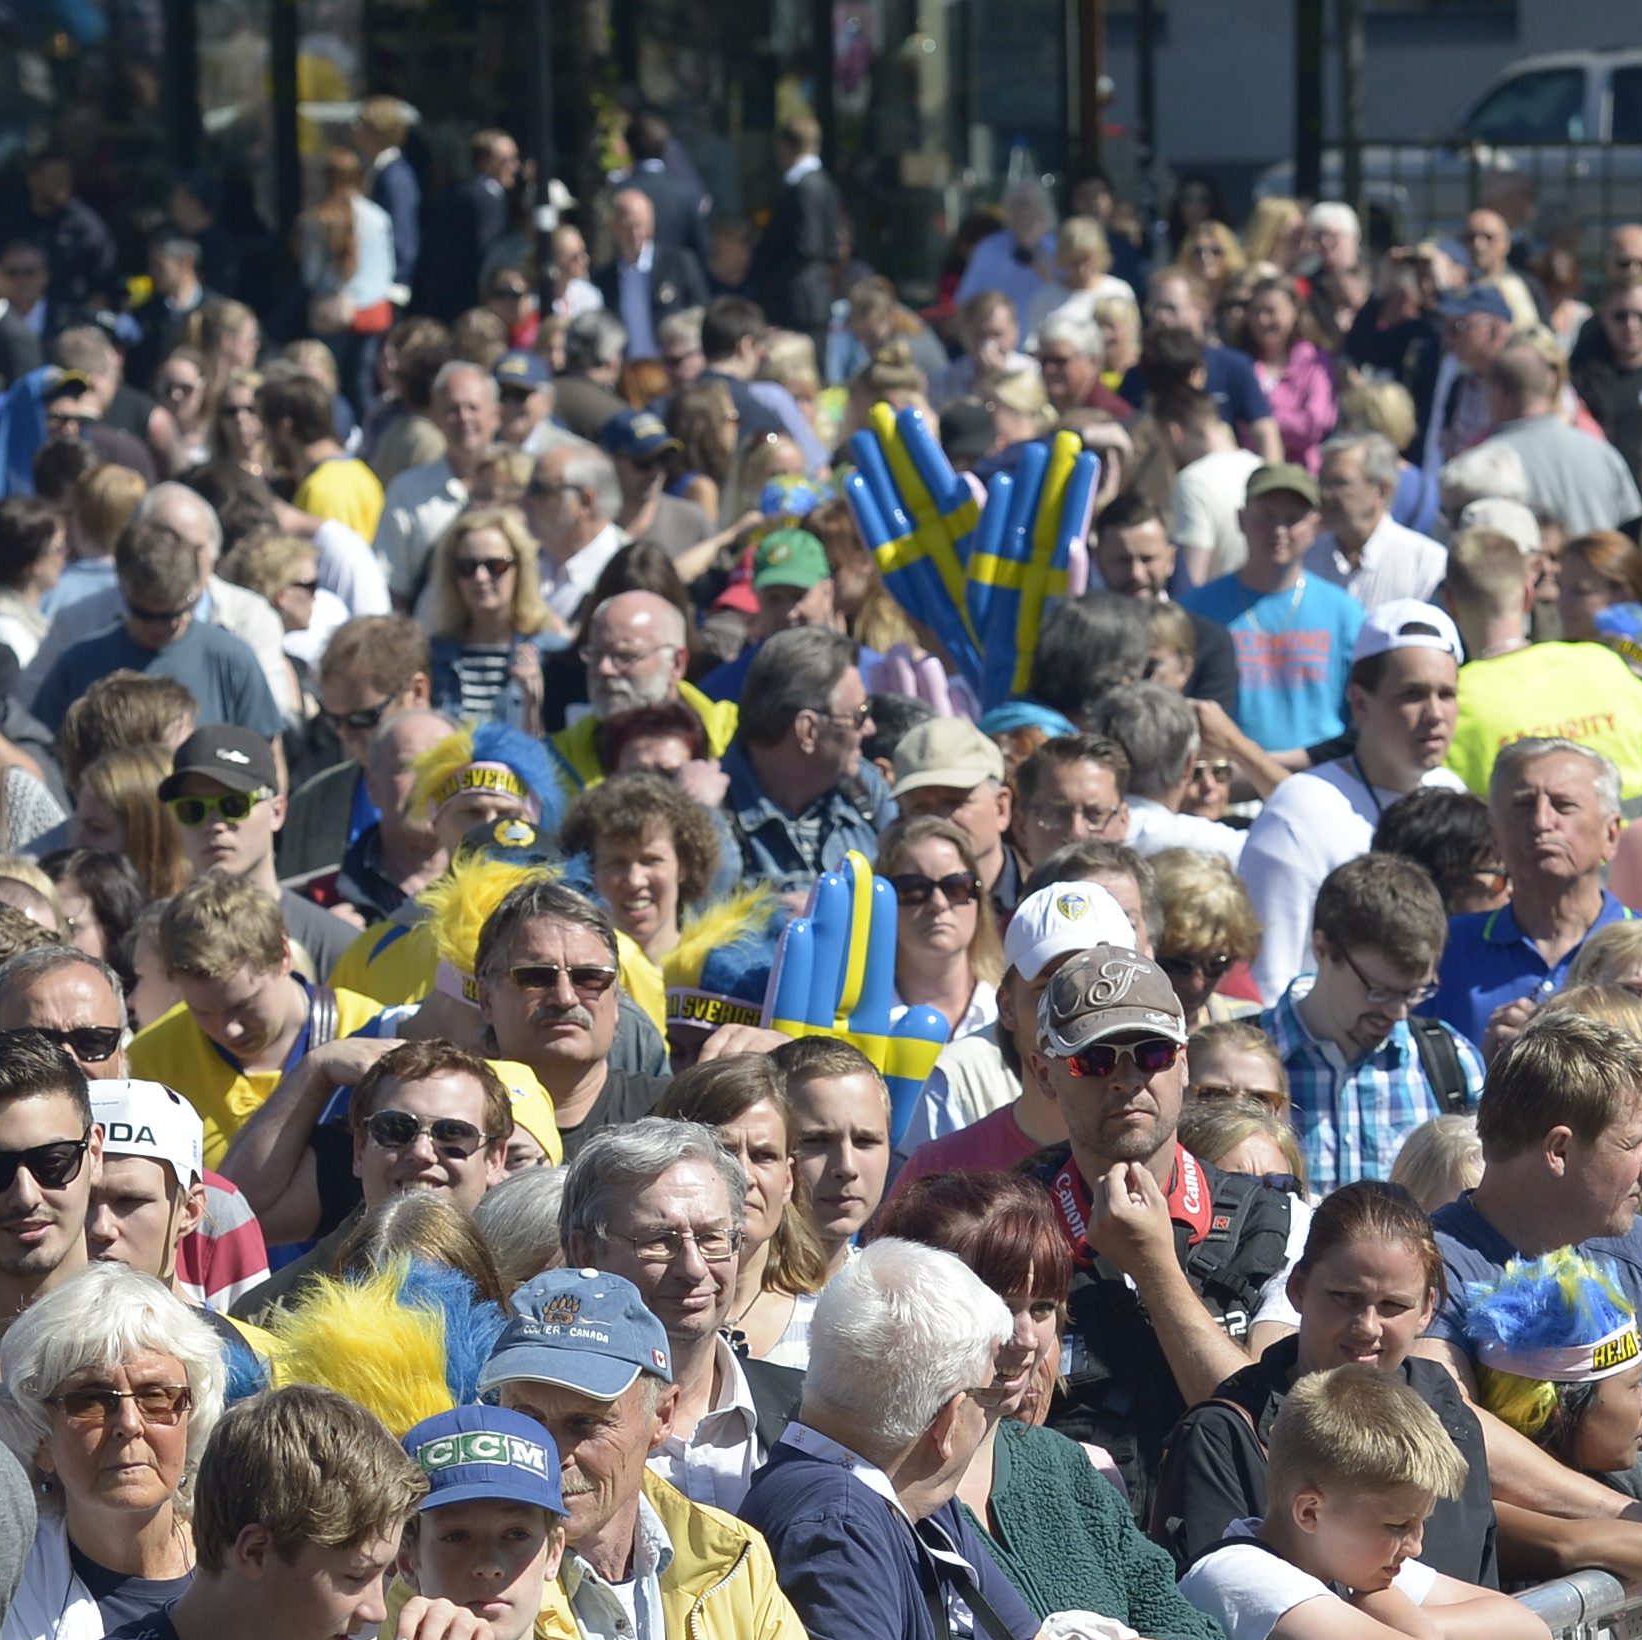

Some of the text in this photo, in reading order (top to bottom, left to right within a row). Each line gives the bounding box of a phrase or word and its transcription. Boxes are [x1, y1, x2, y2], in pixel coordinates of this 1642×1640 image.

[1182, 1149, 1201, 1215] Canon
[1055, 1172, 1089, 1239] Canon
[569, 1327, 609, 1344] CANADA
[1592, 1330, 1639, 1372] HEJA
[426, 1433, 546, 1472] CCM
